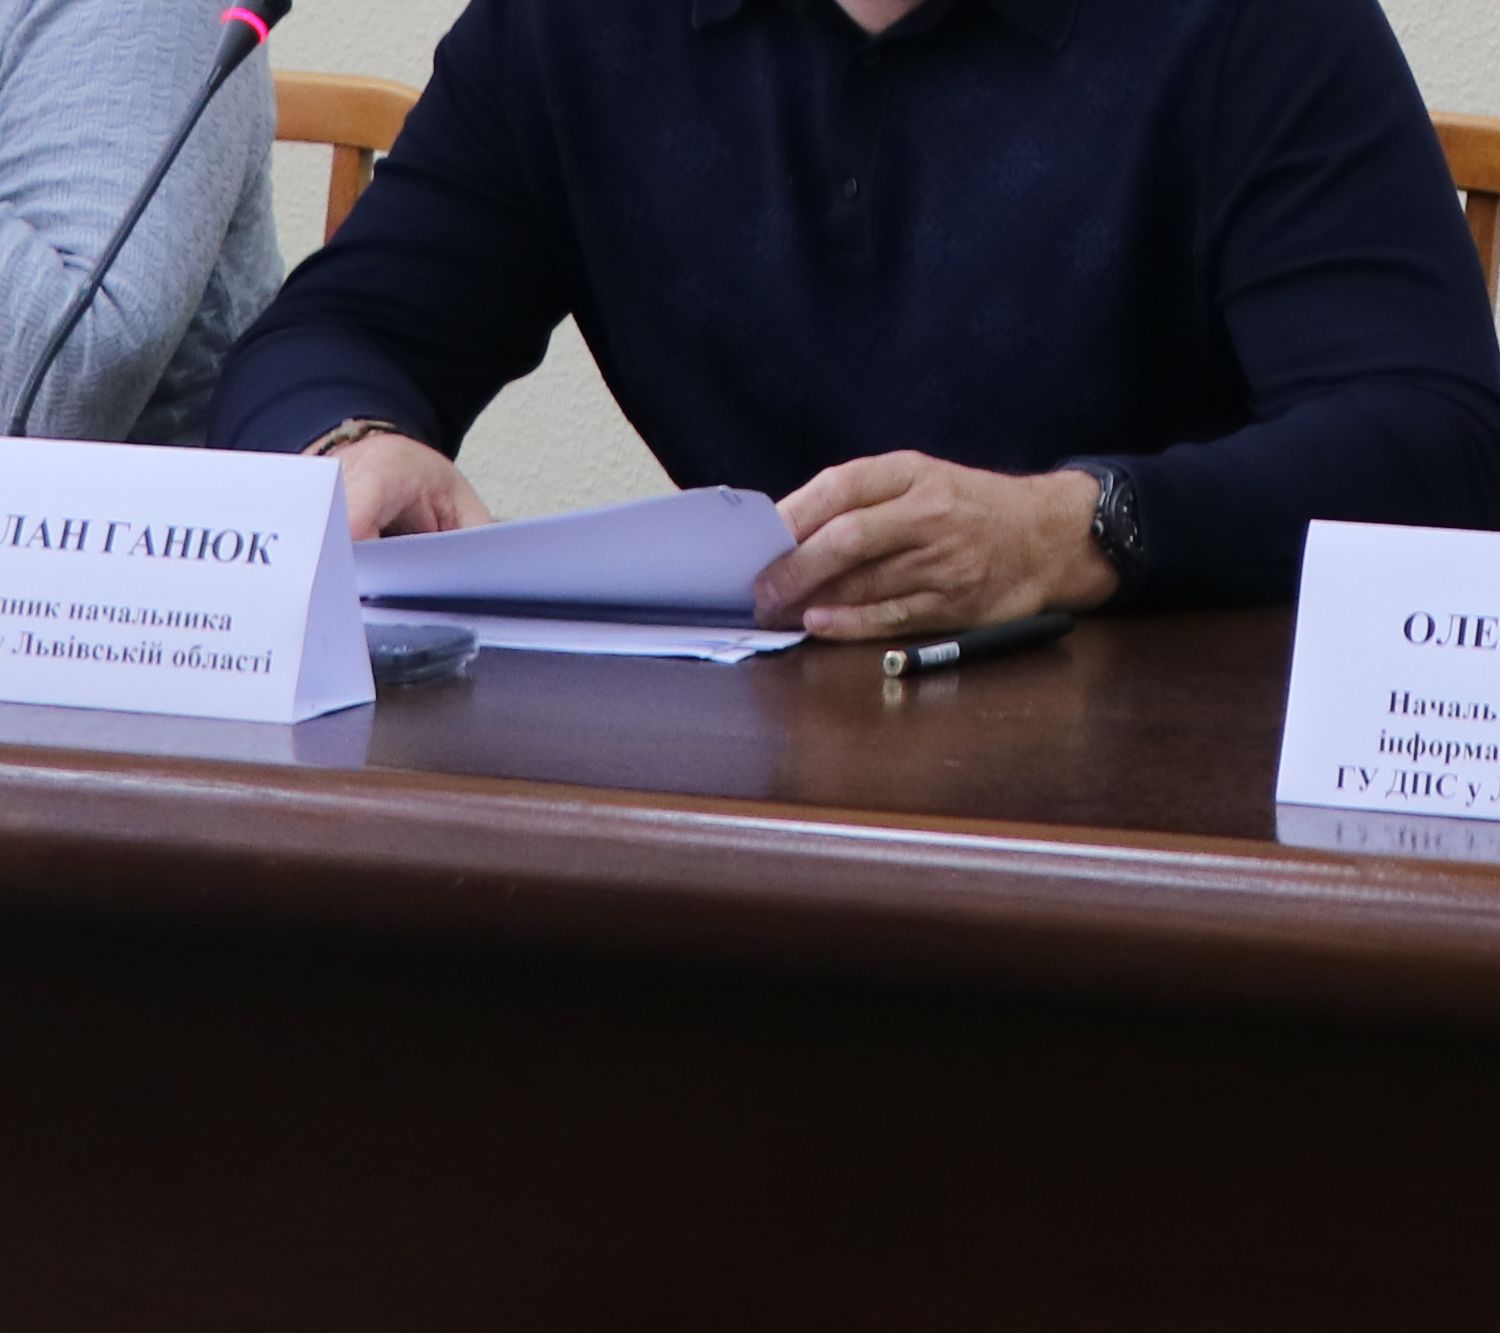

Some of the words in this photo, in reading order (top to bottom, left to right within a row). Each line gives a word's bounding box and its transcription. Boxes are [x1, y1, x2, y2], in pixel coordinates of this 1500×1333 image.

[101, 520, 280, 566] ГАНЮК
[67, 602, 233, 633] начальника
[10, 630, 164, 667] Львівській
[170, 643, 273, 675] області
[1336, 765, 1376, 793] ГУ
[1384, 769, 1458, 800] ДПС
[1464, 781, 1482, 808] у
